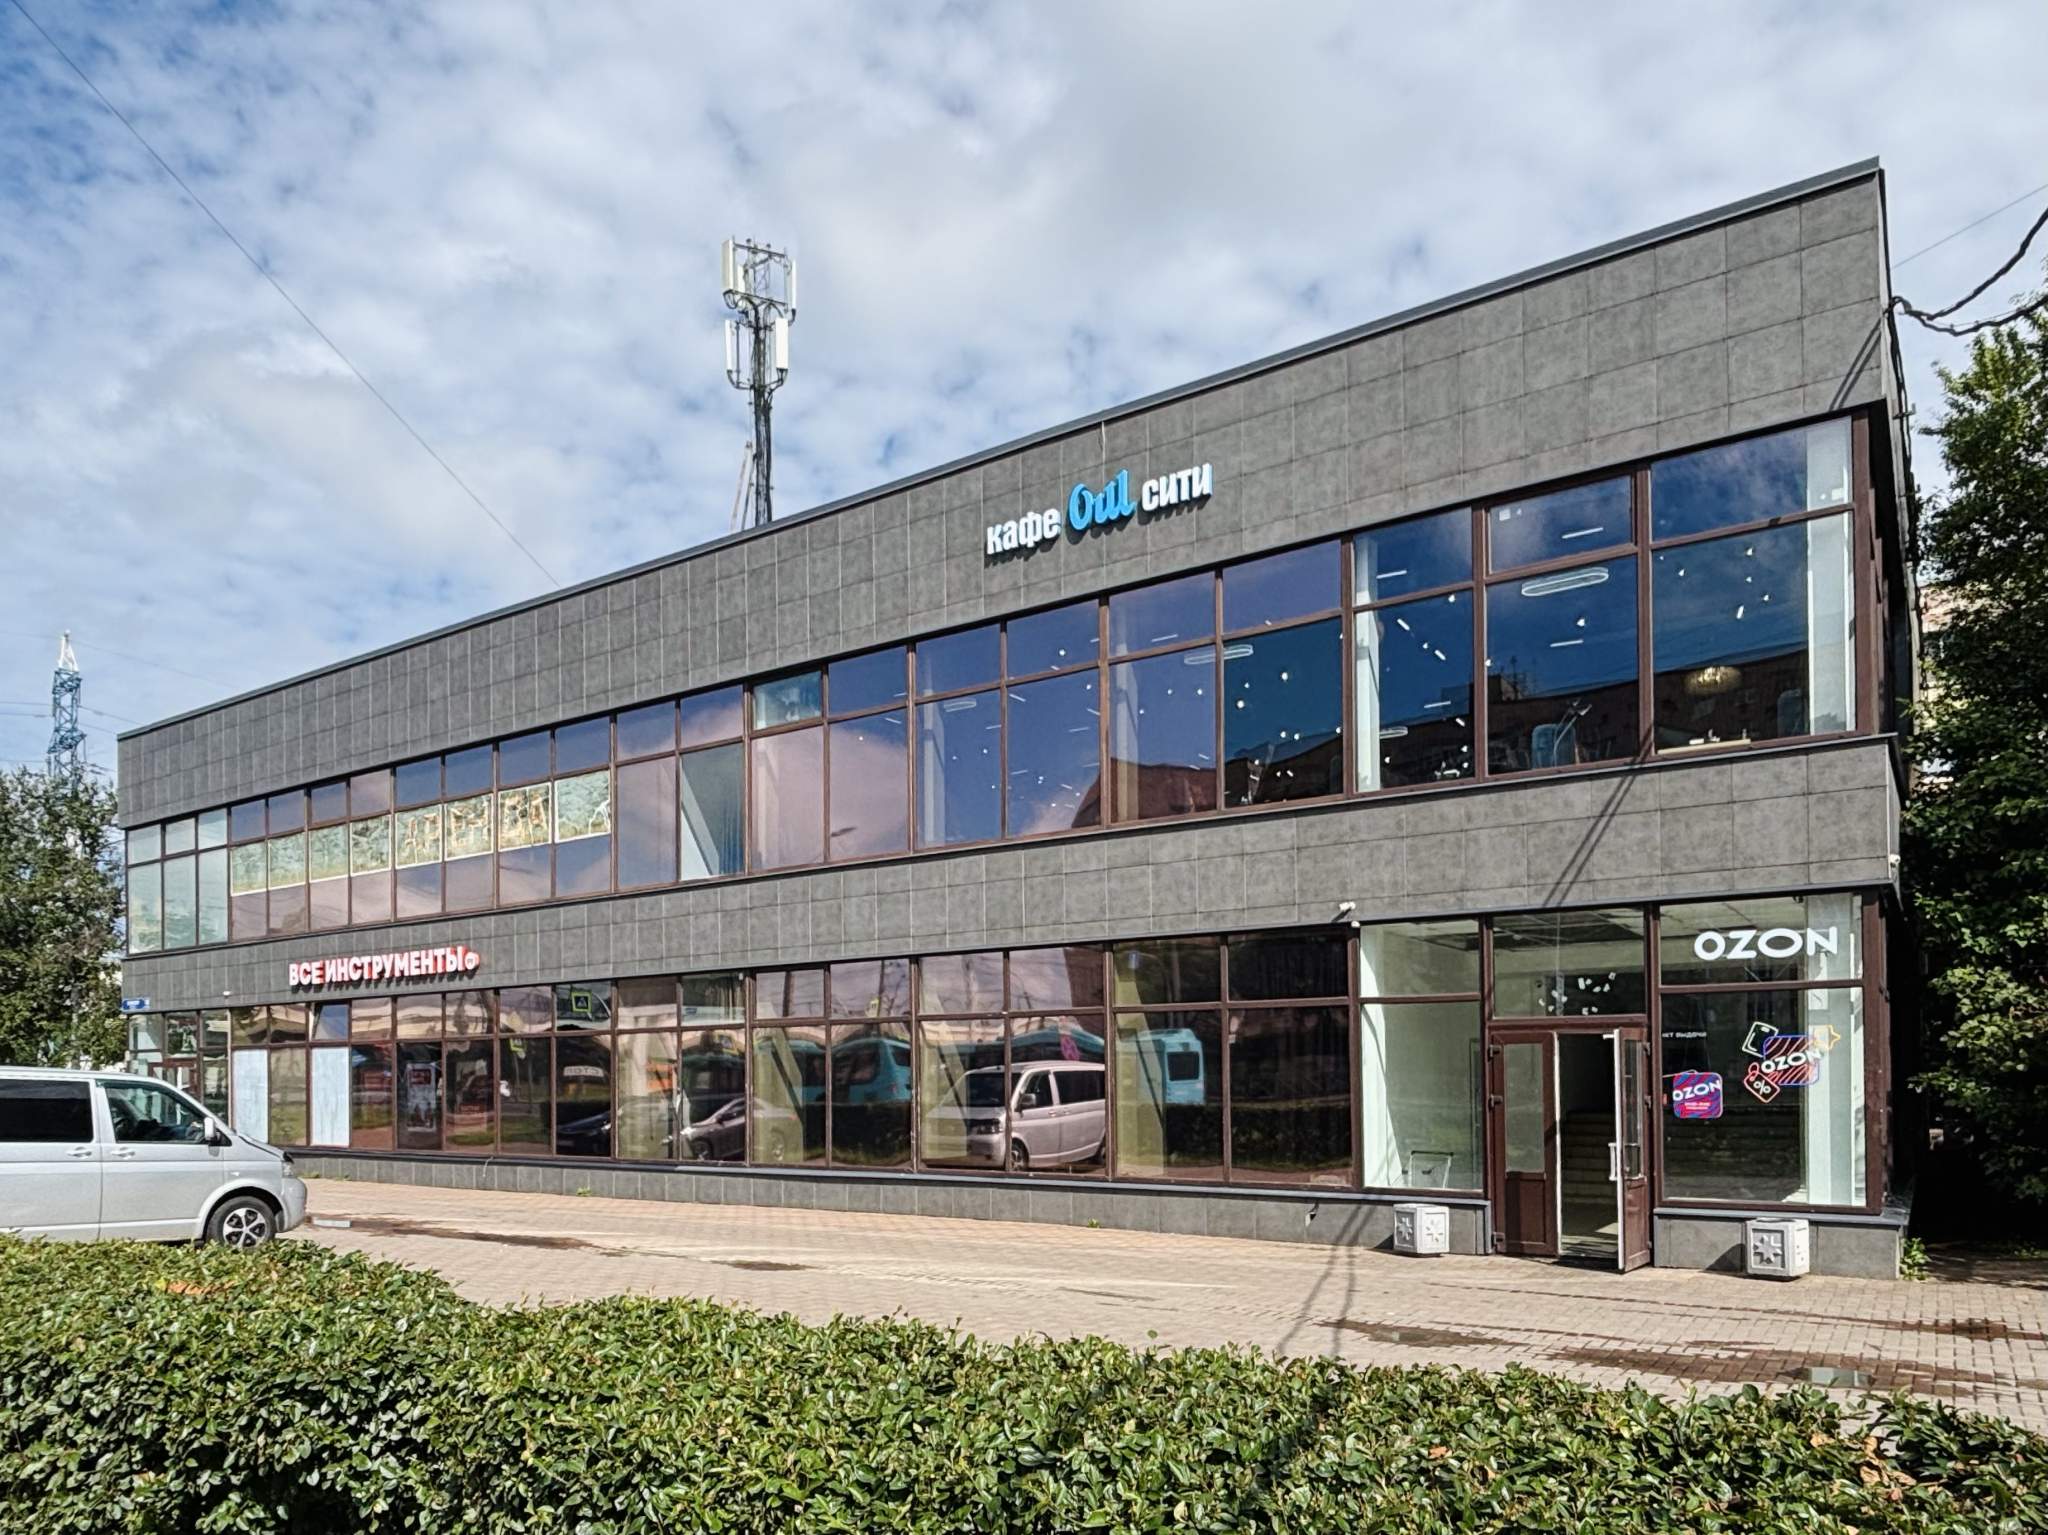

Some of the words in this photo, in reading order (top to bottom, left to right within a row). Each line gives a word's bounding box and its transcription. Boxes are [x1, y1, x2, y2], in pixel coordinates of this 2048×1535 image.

[986, 507, 1063, 555] кафе
[1141, 462, 1213, 512] сити
[1693, 926, 1838, 961] OZON
[324, 945, 468, 983] ИНСТРУМЕНТЫ
[1760, 1048, 1822, 1074] OZON
[1672, 1080, 1721, 1101] OZON
